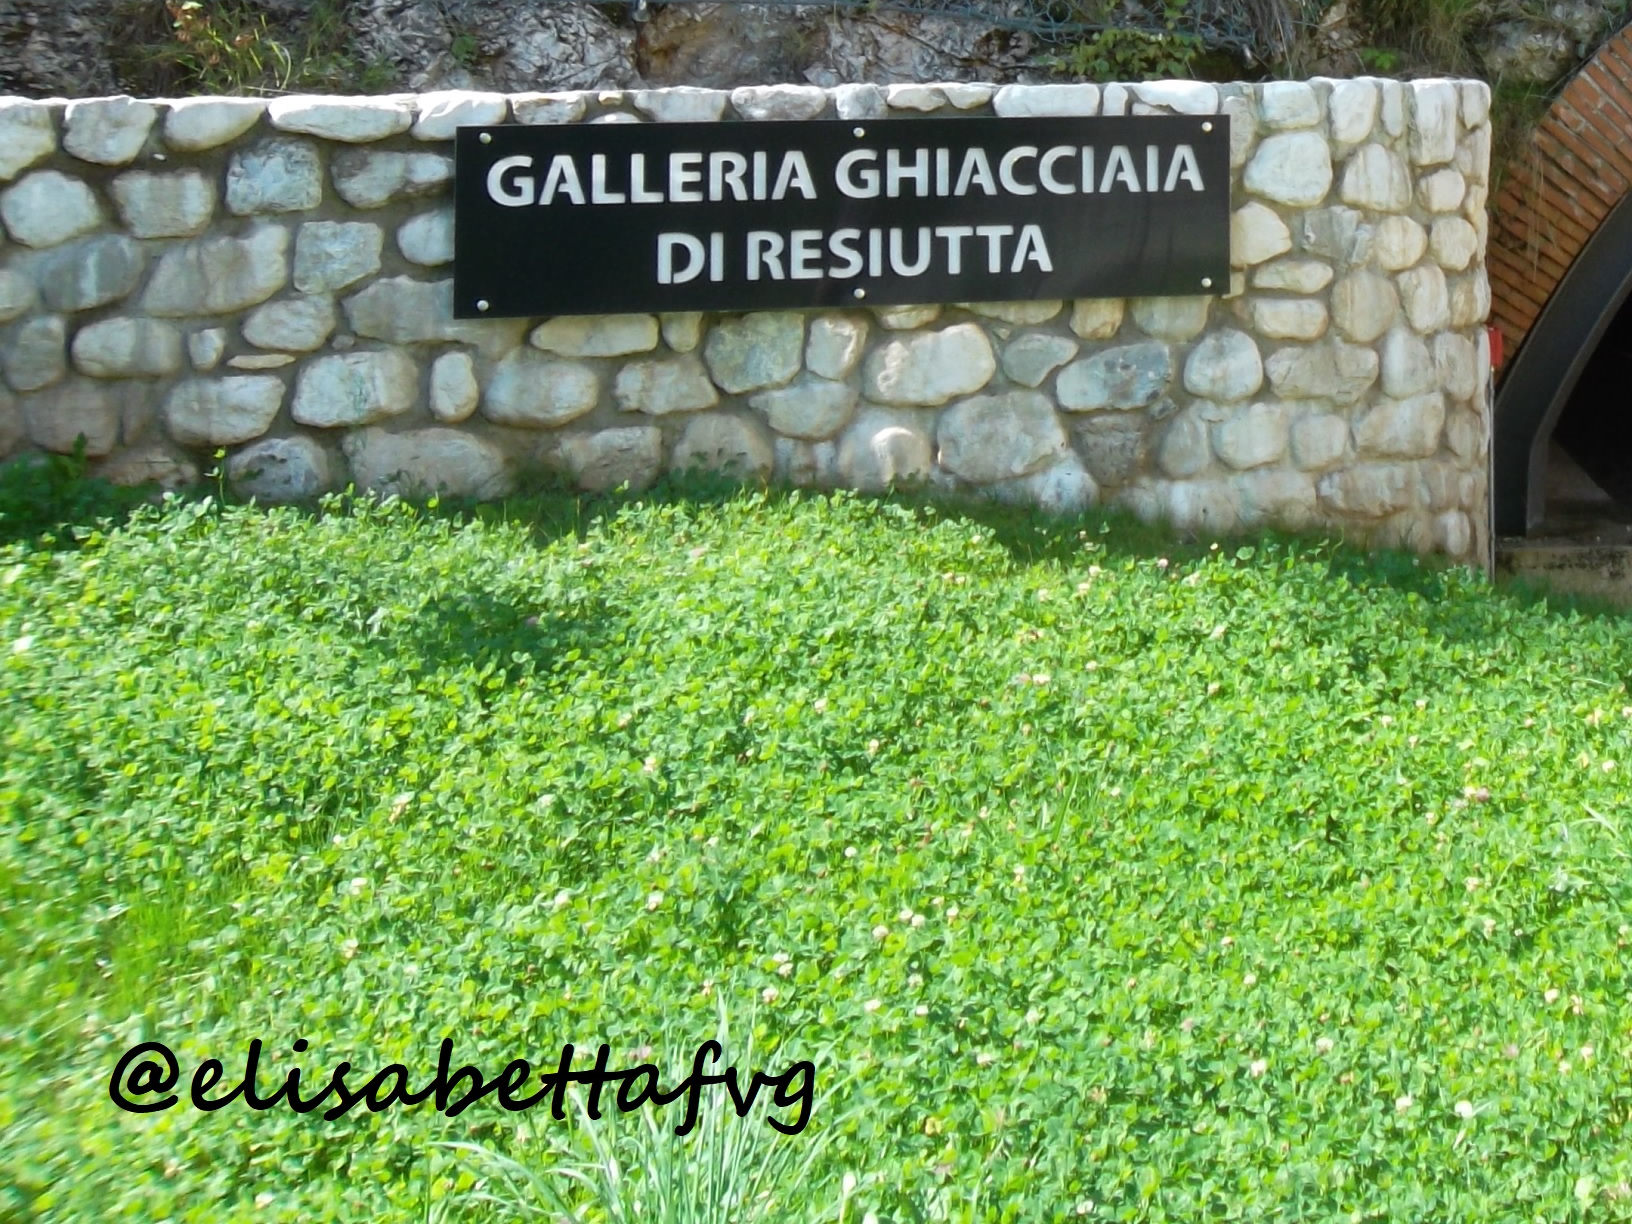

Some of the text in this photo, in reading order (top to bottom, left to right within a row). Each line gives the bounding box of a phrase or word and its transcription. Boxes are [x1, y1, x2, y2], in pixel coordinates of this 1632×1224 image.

[487, 144, 1206, 207] GALLERIA GHIACCIAIA
[656, 224, 1054, 285] DI RESIUTTA
